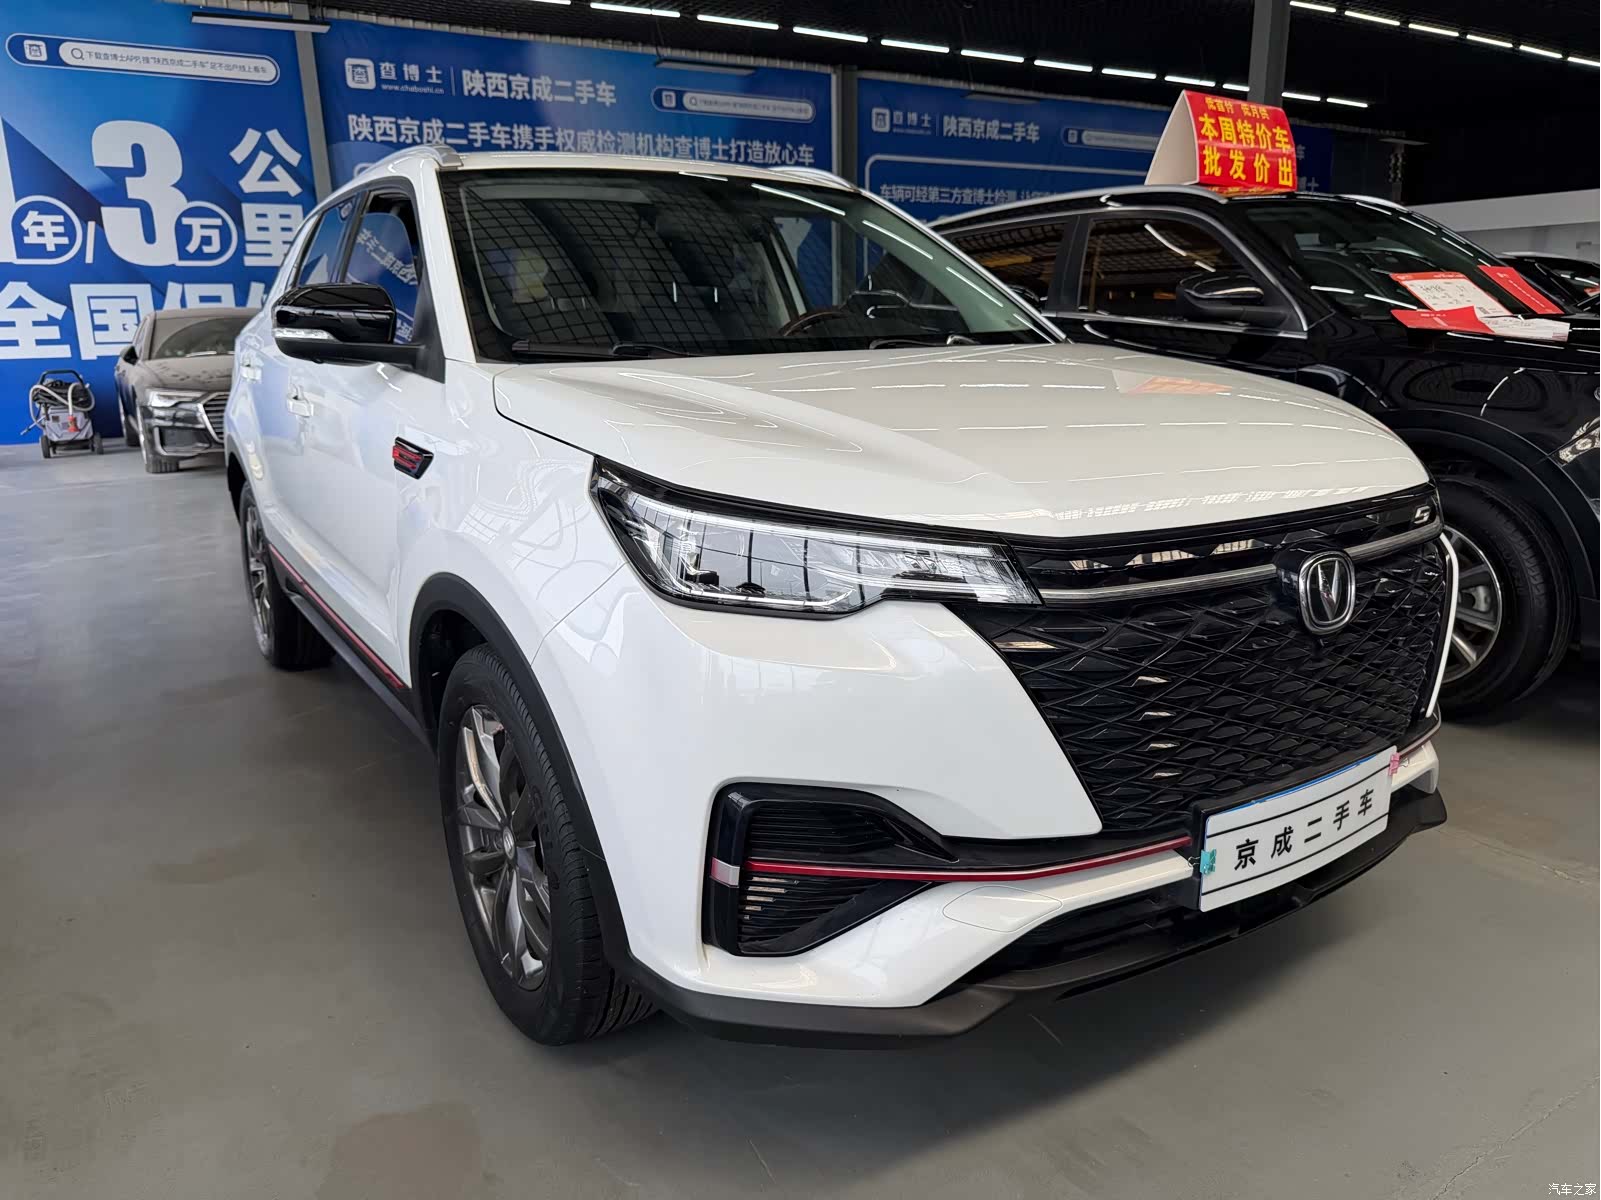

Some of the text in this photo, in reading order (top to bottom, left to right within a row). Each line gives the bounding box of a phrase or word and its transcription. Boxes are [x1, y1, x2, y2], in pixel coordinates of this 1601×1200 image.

[379, 62, 443, 84] 查博士
[461, 69, 617, 106] 陕西京成二手车
[348, 114, 815, 166] 陕西京成二手车携手权威检测机构查博士打造放心车
[943, 115, 1040, 144] 陕西京成二手车
[1198, 113, 1291, 153] 本周特价车
[1202, 144, 1293, 187] 批发价出
[1234, 788, 1374, 871] 京成二手车
